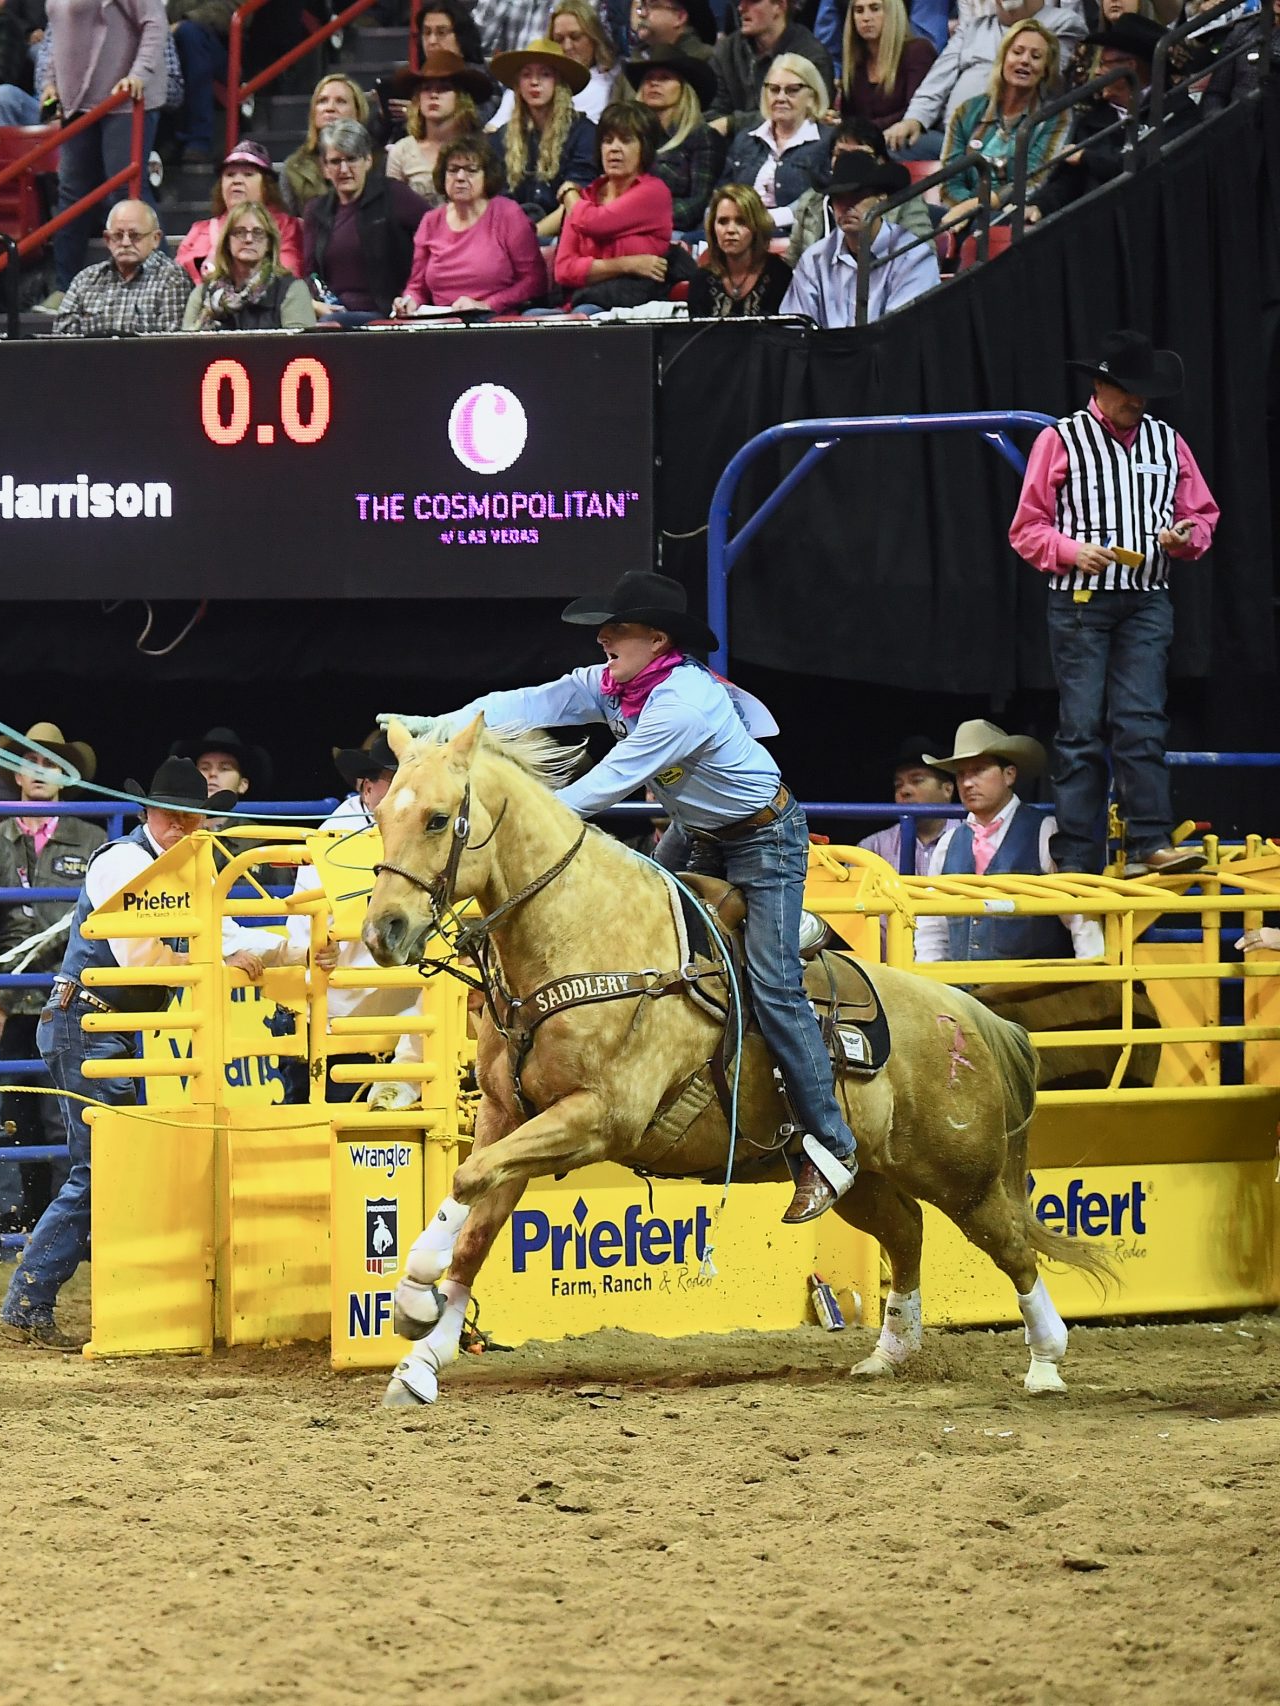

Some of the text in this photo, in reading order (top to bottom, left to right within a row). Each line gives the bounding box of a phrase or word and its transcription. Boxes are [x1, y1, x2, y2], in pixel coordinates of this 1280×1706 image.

[201, 357, 330, 445] 0.0
[355, 492, 405, 521] THE
[457, 529, 487, 545] LAS
[490, 529, 540, 545] VEGAS
[123, 889, 191, 912] Priefert
[535, 975, 628, 1012] SADDLERY
[349, 1143, 412, 1177] Wrangler
[512, 1195, 712, 1274] Priefert
[551, 1267, 713, 1298] Farm, Ranch & Rodeo
[349, 1291, 400, 1338] NF
